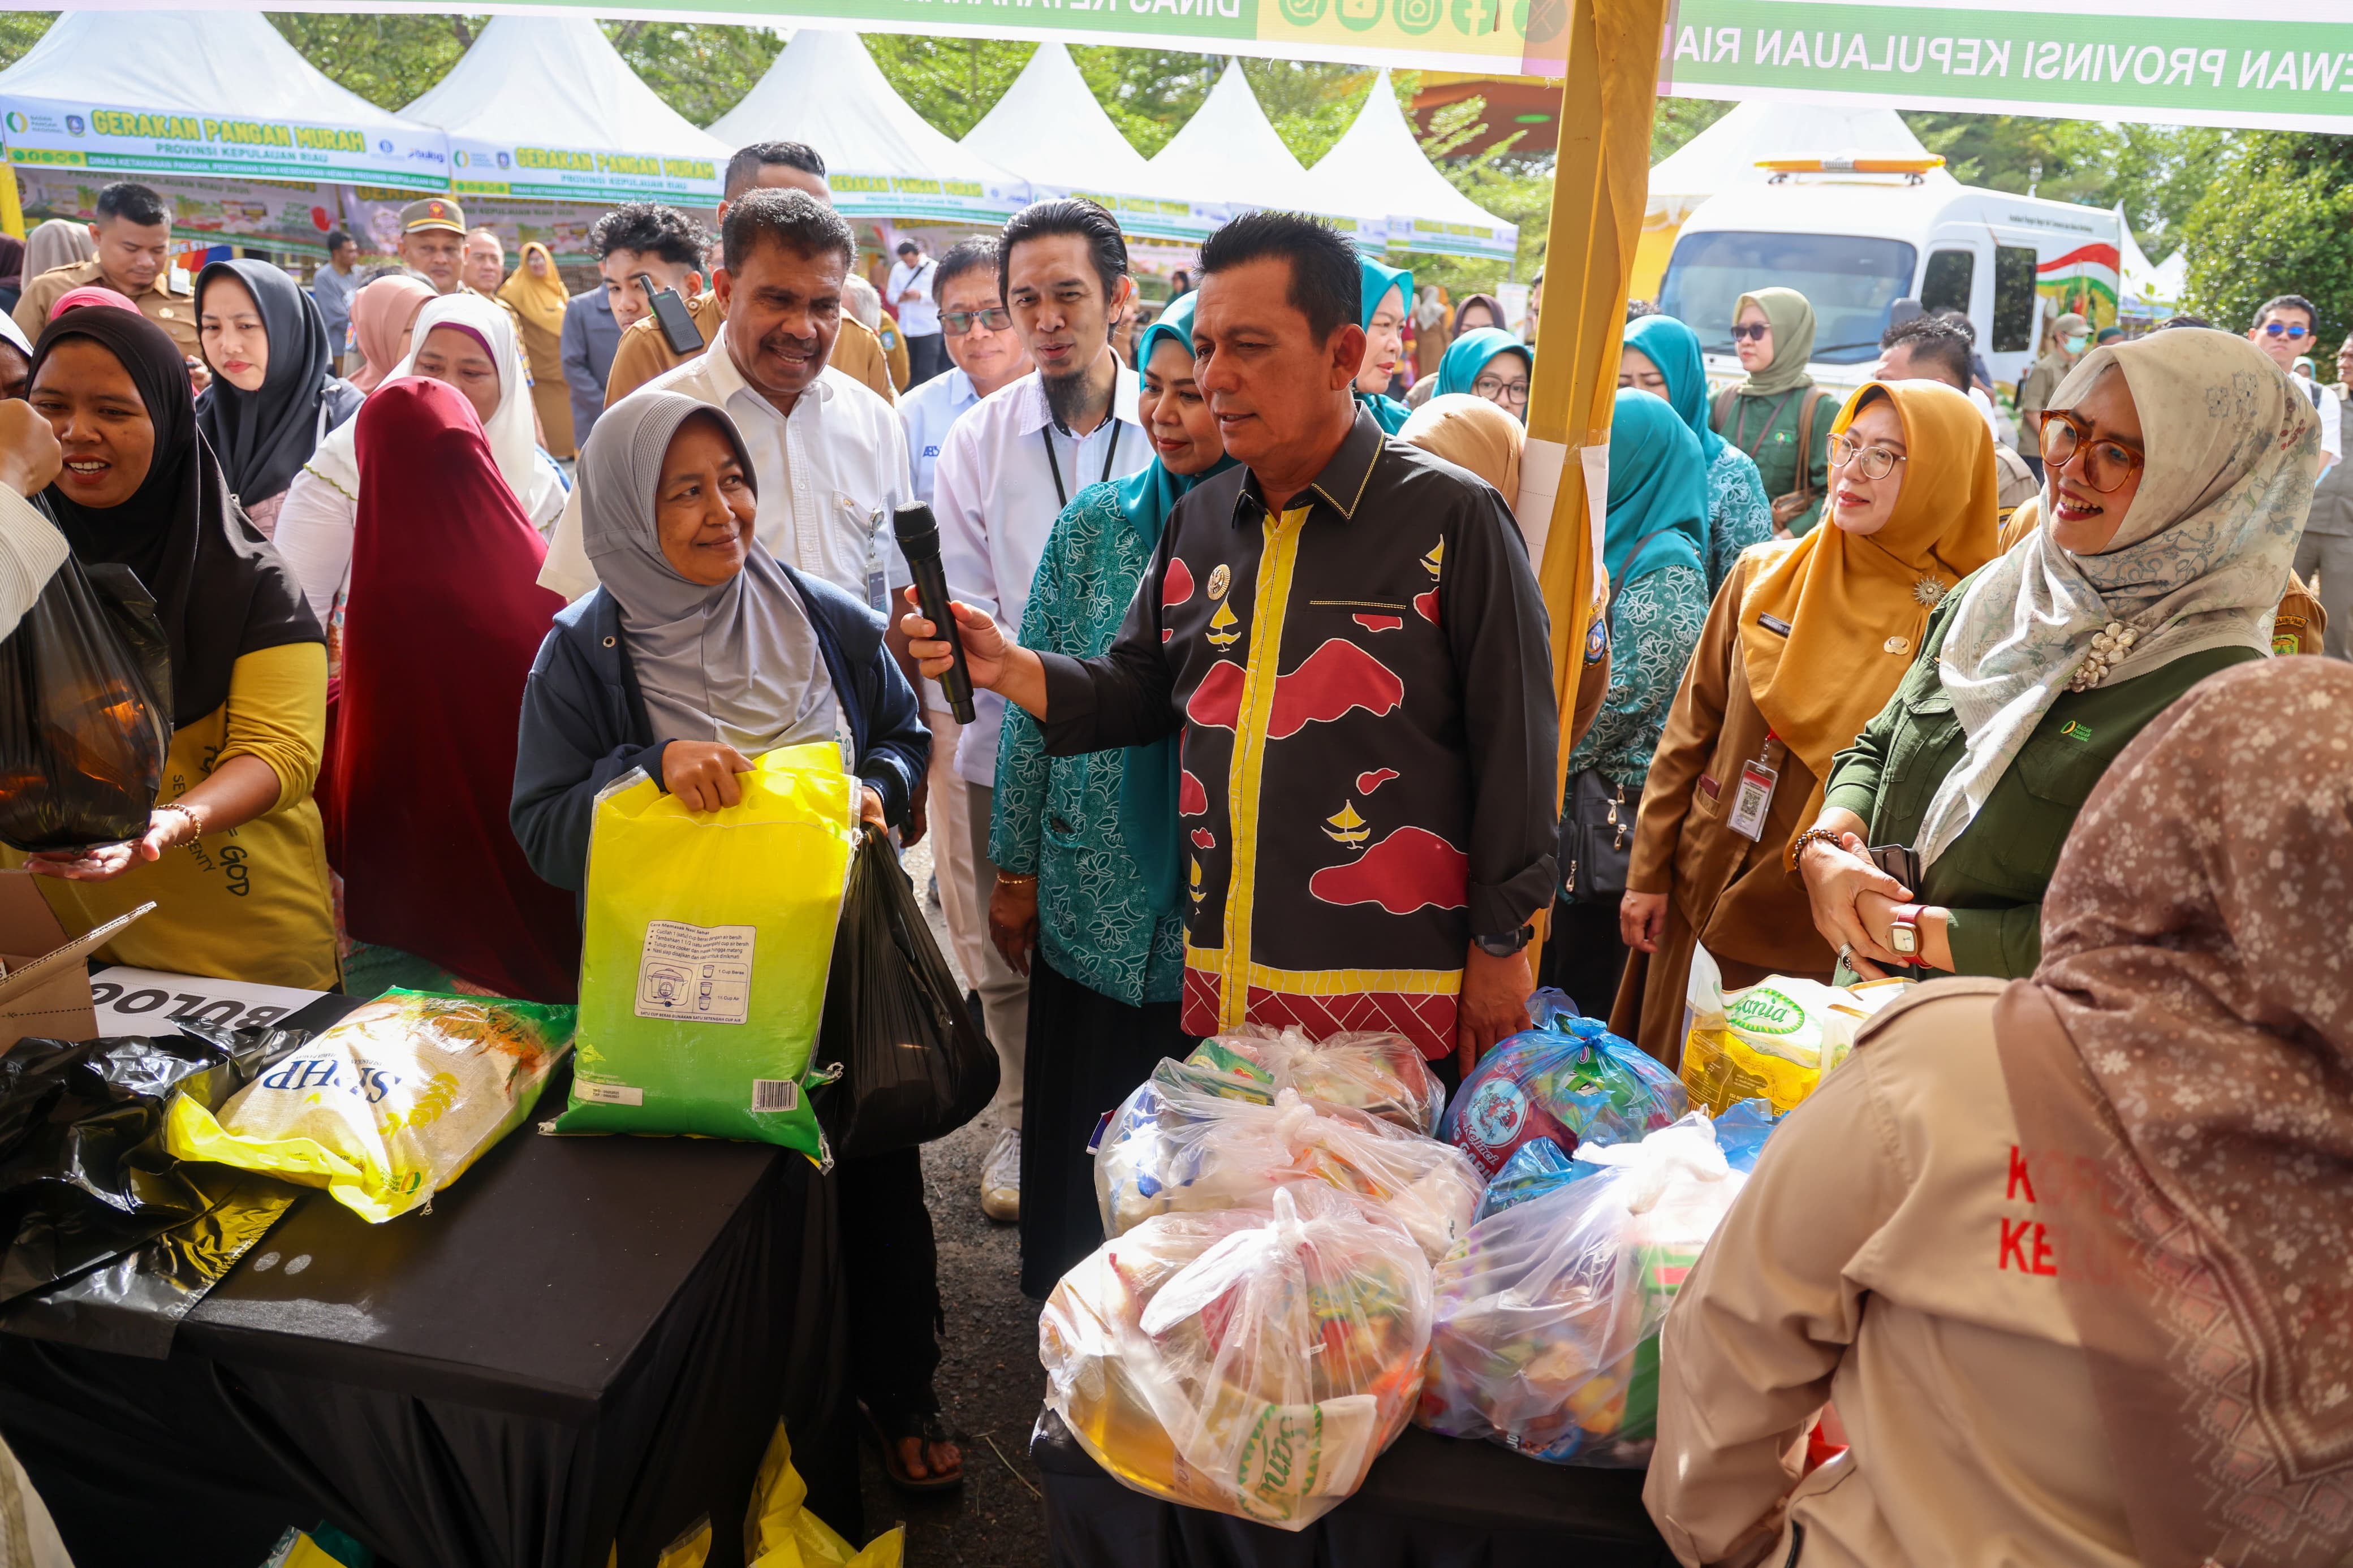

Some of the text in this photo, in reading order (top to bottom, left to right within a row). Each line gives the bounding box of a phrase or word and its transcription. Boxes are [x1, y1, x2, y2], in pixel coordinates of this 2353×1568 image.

[92, 109, 366, 153] GERAKAN PANGAN MURAH
[156, 144, 328, 162] PROVINSI KEPULAUAN RIAU
[515, 146, 593, 171] GERAKAN
[596, 153, 661, 176] PANGAN
[663, 158, 716, 180] MURAH
[92, 982, 292, 1029] BULOG
[1463, 1122, 1499, 1172] Kelinci
